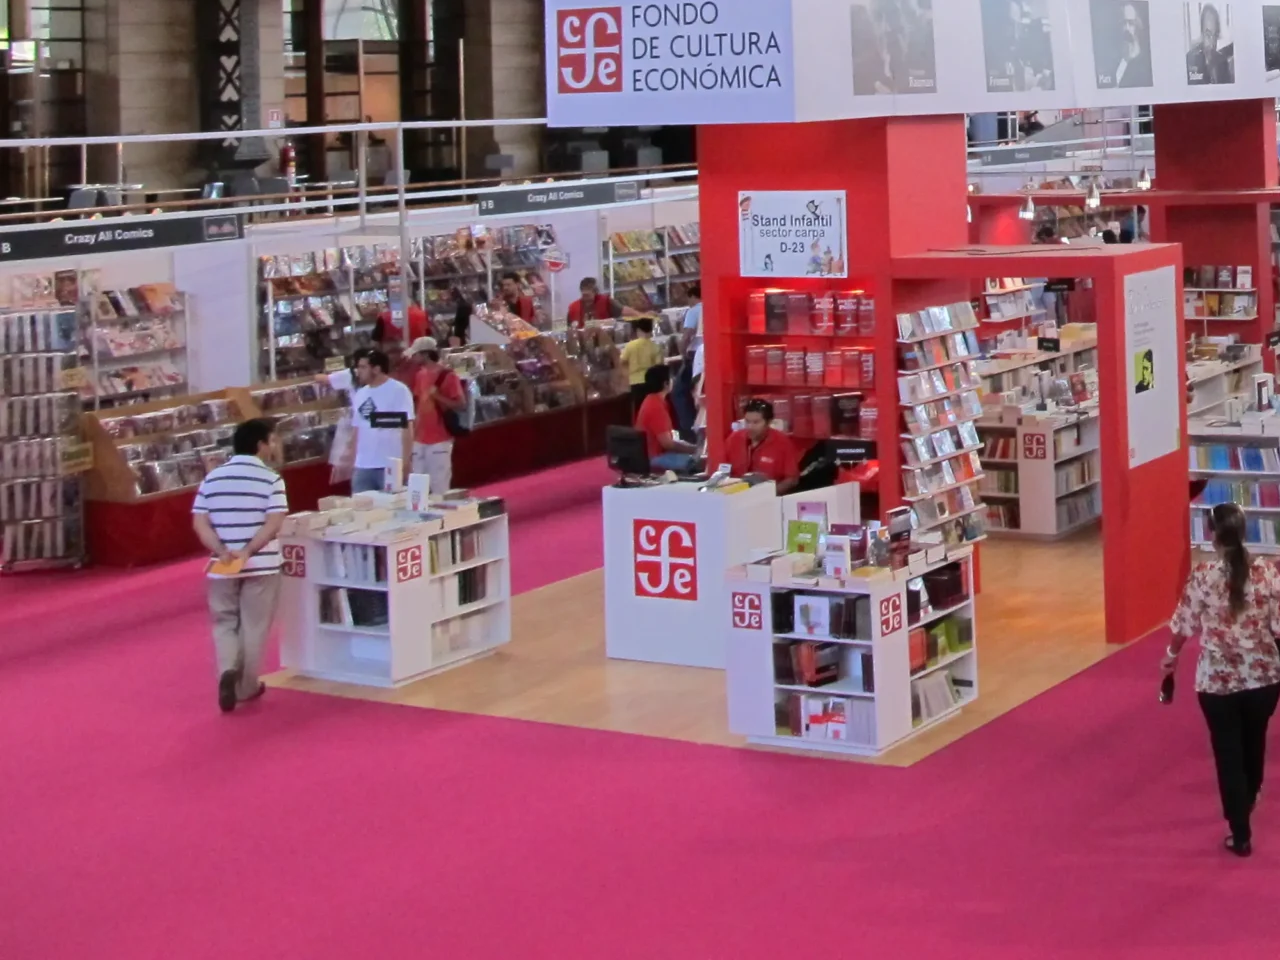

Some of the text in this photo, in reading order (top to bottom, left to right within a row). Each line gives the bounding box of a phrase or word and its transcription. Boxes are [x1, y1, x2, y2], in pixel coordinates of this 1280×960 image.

[632, 1, 719, 28] FONDO
[632, 30, 781, 59] DE CULTURA
[632, 62, 782, 92] ECONÓMICA
[527, 193, 547, 204] Crazy
[558, 190, 584, 200] Comics
[752, 214, 832, 227] Stand Infantil
[64, 233, 96, 245] Crazy
[115, 228, 154, 240] Comics
[760, 229, 825, 240] sector carpa
[780, 242, 805, 253] D-23
